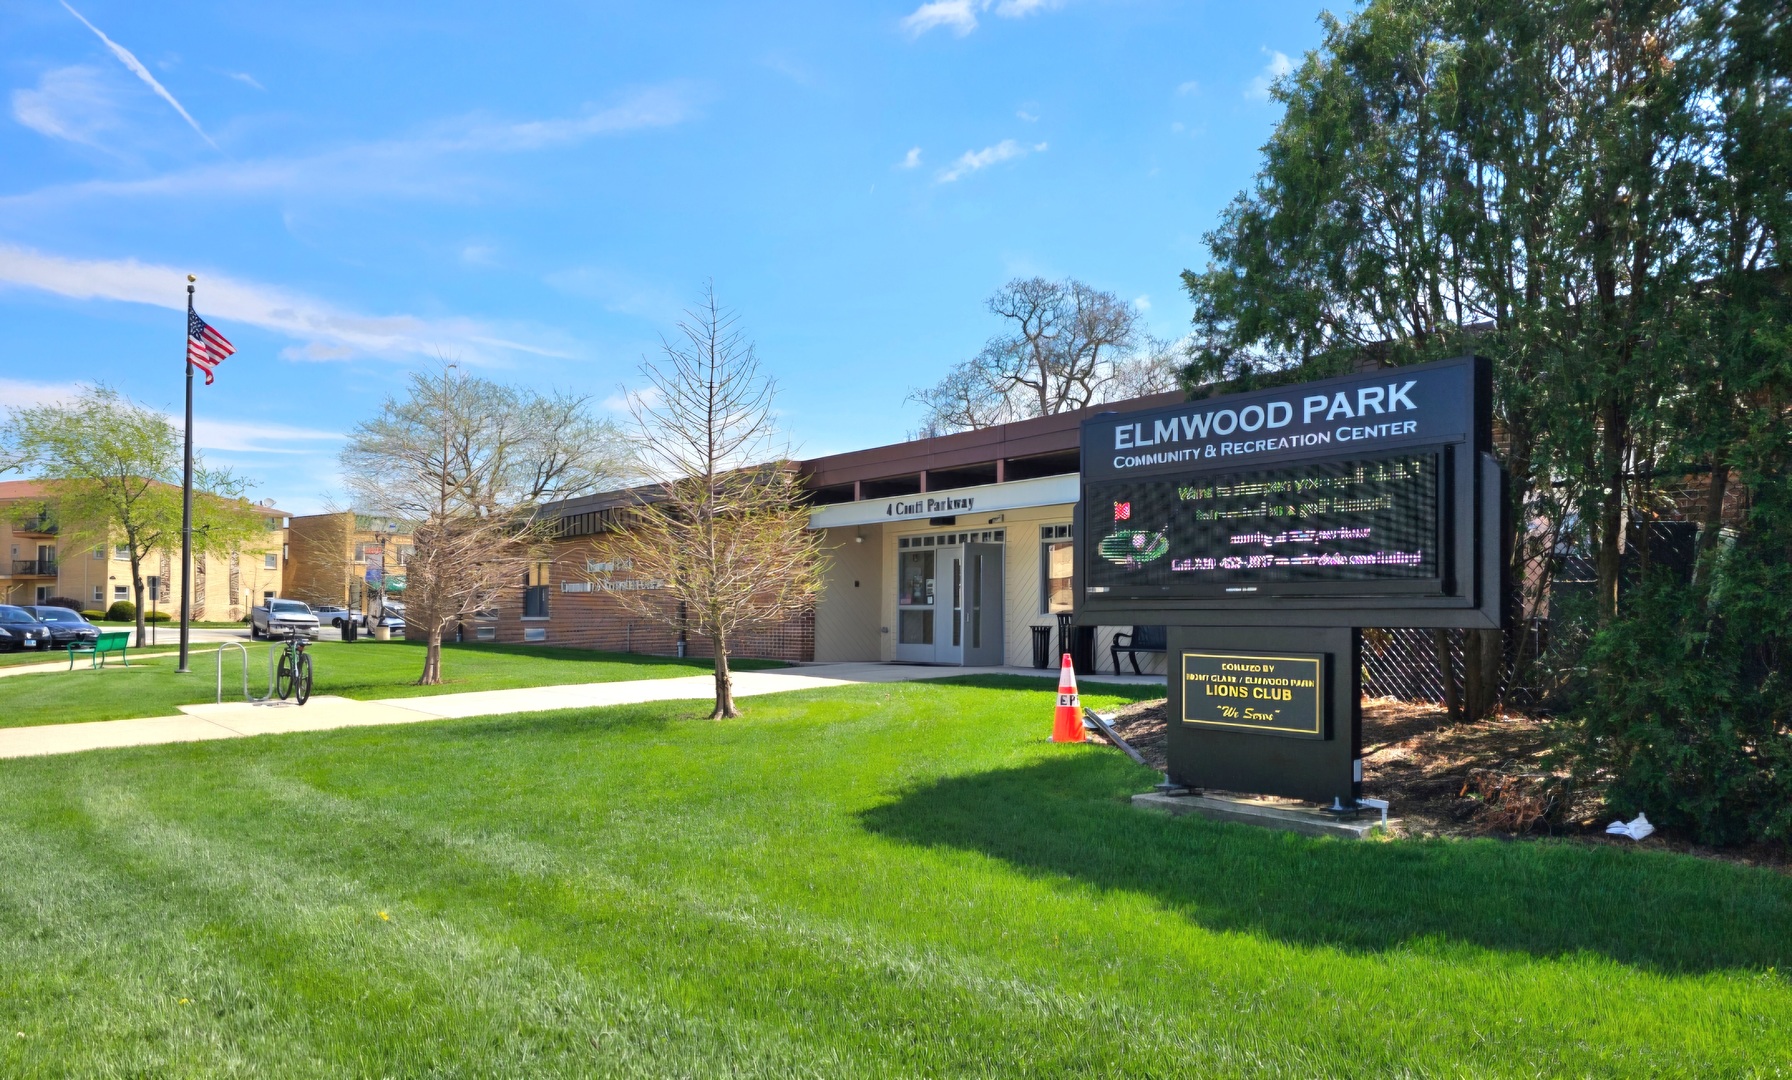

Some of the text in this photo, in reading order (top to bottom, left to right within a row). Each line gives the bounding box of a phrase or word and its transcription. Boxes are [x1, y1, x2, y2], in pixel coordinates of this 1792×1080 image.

[1114, 380, 1417, 450] ELMWOOD PARK
[1113, 420, 1417, 469] COMMUNITY & RECREATION CENTER
[886, 503, 892, 516] 4
[927, 497, 974, 511] Parkway
[1206, 684, 1293, 701] LIONS CLUB
